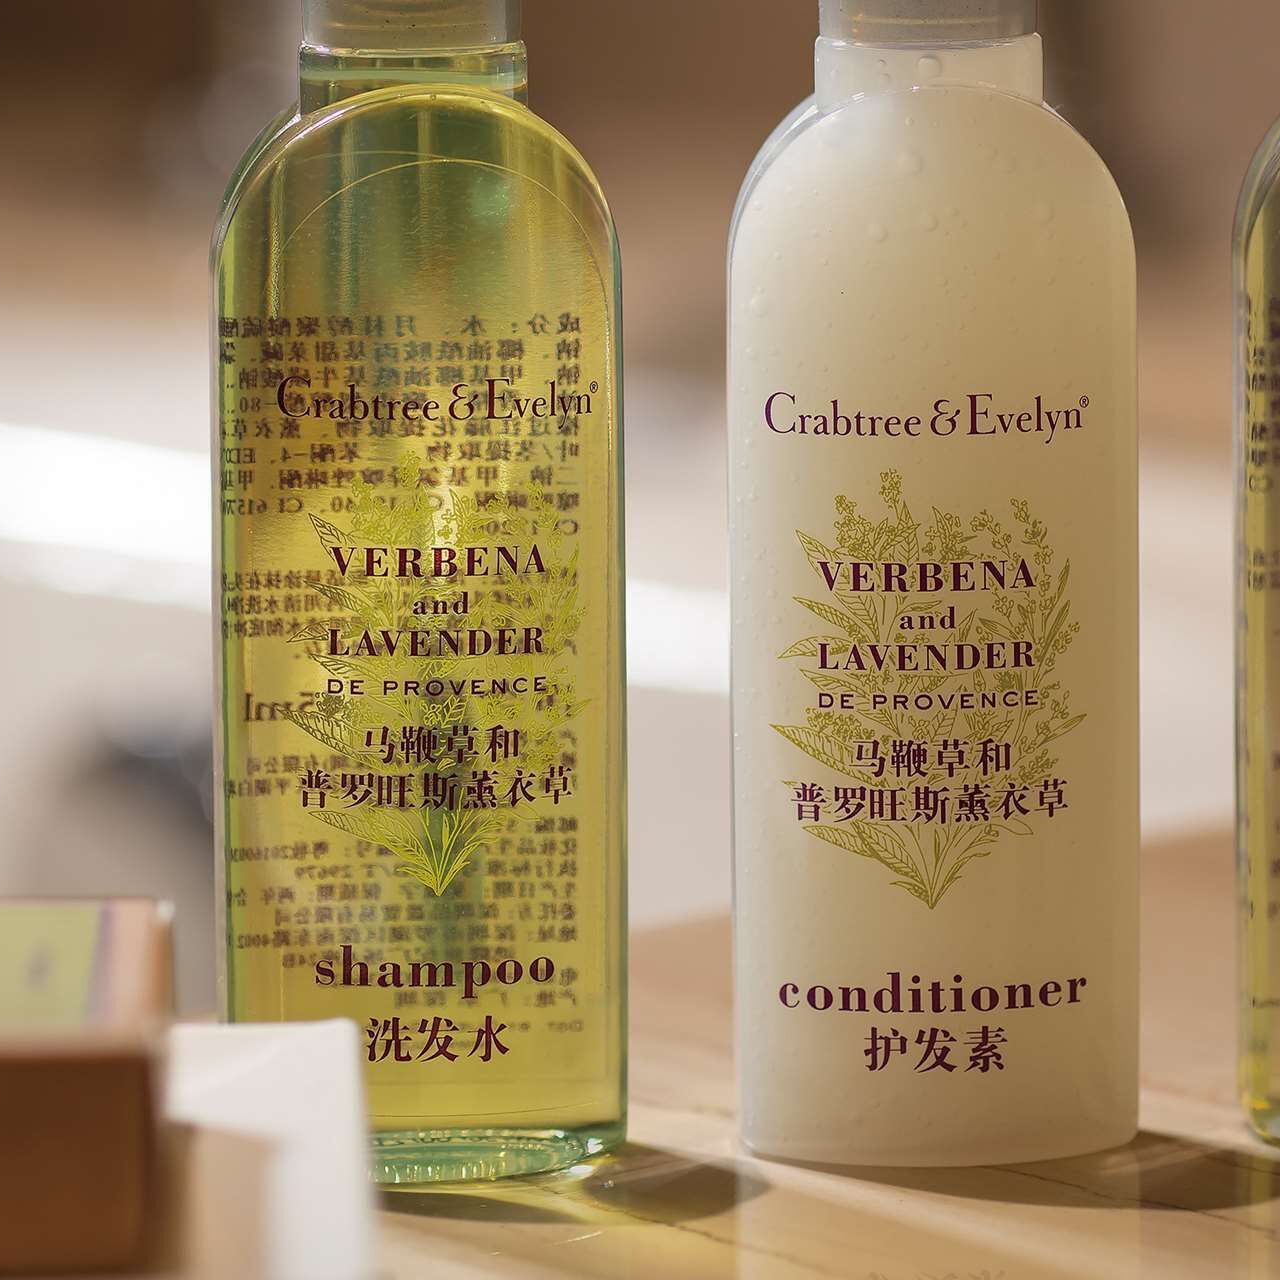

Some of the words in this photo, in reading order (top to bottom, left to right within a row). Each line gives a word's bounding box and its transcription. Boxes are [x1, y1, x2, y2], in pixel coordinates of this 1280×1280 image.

[276, 375, 440, 421] Crabtree
[448, 383, 484, 420] &
[764, 392, 922, 437] Crabtree
[929, 399, 960, 437] &
[330, 543, 547, 578] VERBENA
[817, 557, 1037, 592] VERBENA
[412, 592, 470, 615] and
[899, 606, 957, 631] and
[328, 626, 544, 657] LAVENDER
[817, 640, 1035, 672] LAVENDER
[327, 679, 365, 696] DE
[383, 676, 548, 696] PROVENCE
[818, 692, 855, 709] DE
[872, 690, 1039, 709] PROVENCE
[364, 724, 520, 764] 马鞭草和
[849, 738, 1012, 778] 马鞭草和
[296, 766, 573, 811] 普罗旺斯薰衣草
[791, 778, 1069, 825] 普罗旺斯薰衣草
[315, 944, 556, 1000] shampoo
[778, 971, 1087, 1014] conditioner
[366, 1015, 511, 1063] 洗发水
[863, 1025, 1009, 1073] 护发素
